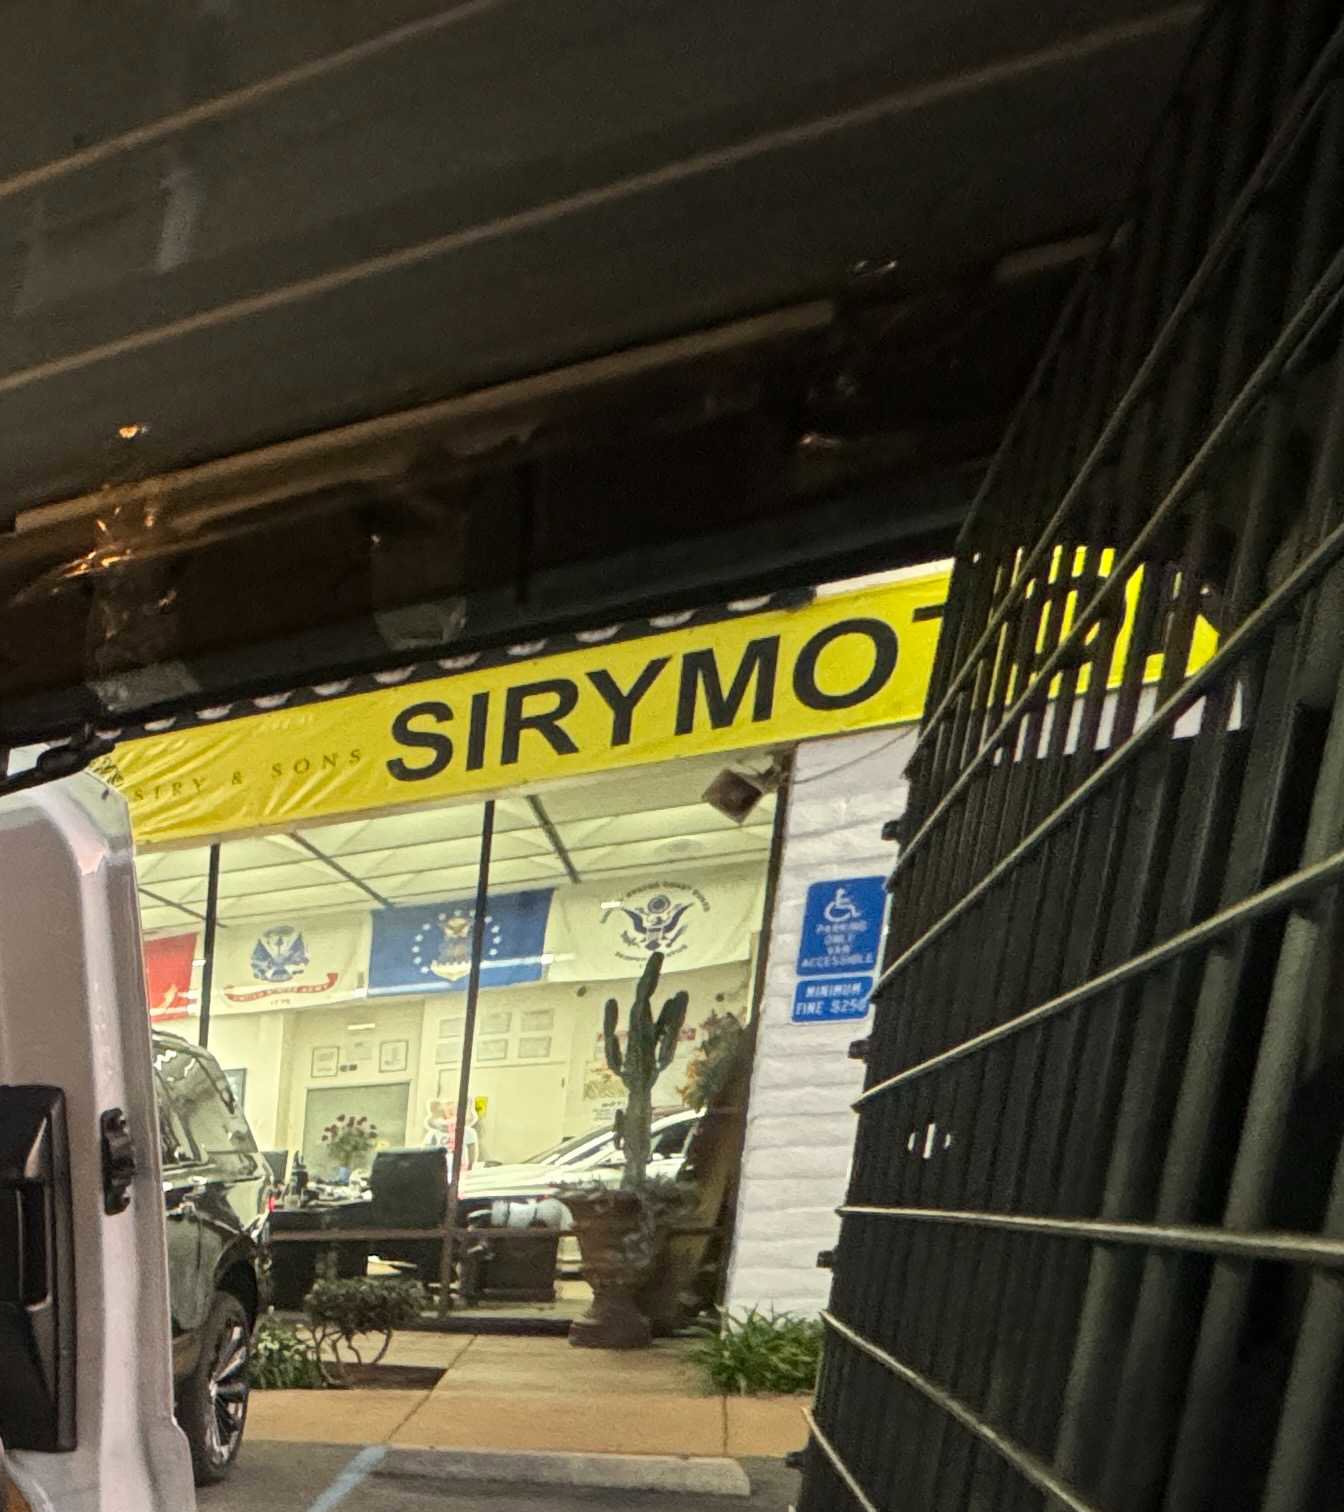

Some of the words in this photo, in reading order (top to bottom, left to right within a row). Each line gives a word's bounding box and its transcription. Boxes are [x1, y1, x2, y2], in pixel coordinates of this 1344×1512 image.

[386, 604, 944, 782] SIRYMO
[135, 777, 208, 801] SIRY
[231, 771, 243, 786] &
[271, 749, 361, 778] SONS
[801, 952, 874, 968] ACCESSIBLE
[805, 983, 862, 999] MINIMUM
[796, 1001, 824, 1016] FINE
